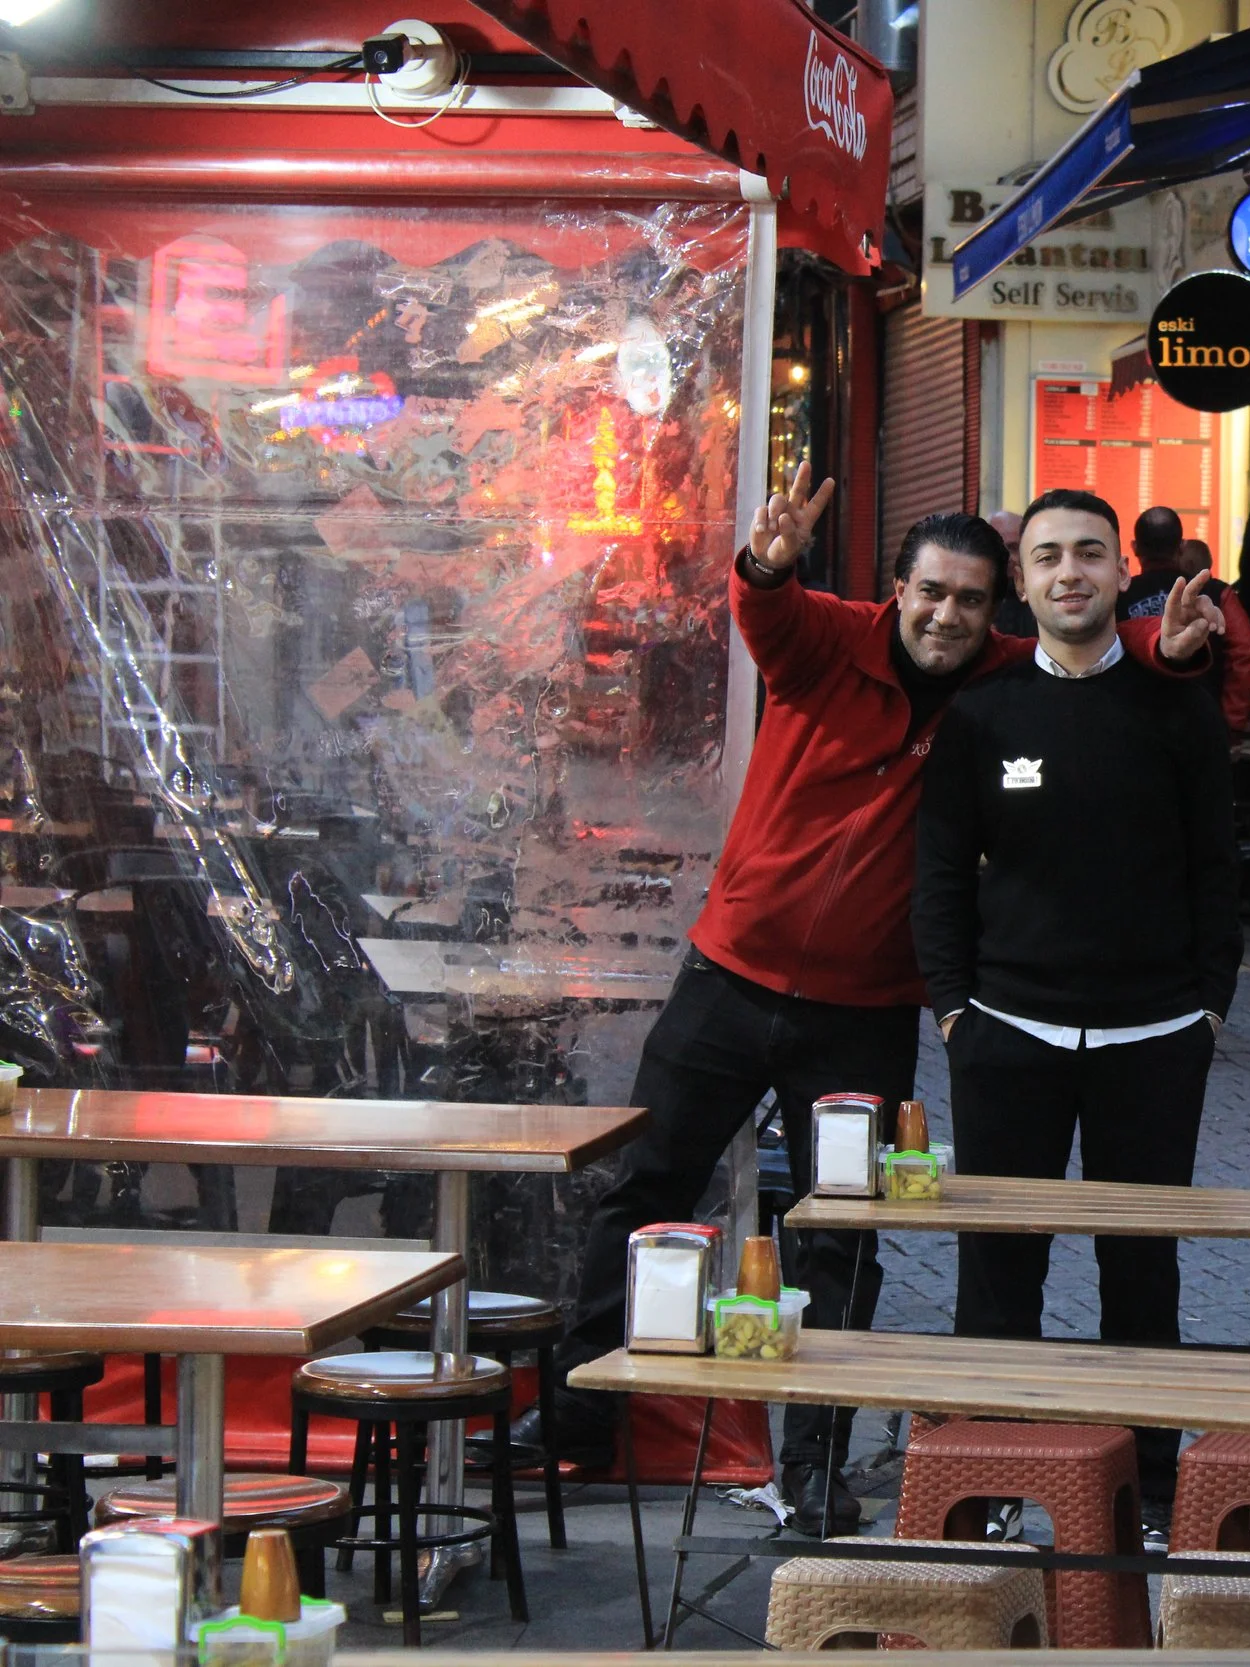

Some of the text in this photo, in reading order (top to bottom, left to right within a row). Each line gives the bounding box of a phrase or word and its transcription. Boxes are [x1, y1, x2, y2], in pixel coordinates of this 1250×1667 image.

[804, 29, 867, 163] Coca-Cola
[992, 281, 1138, 311] Self Servis
[1157, 317, 1196, 332] eski
